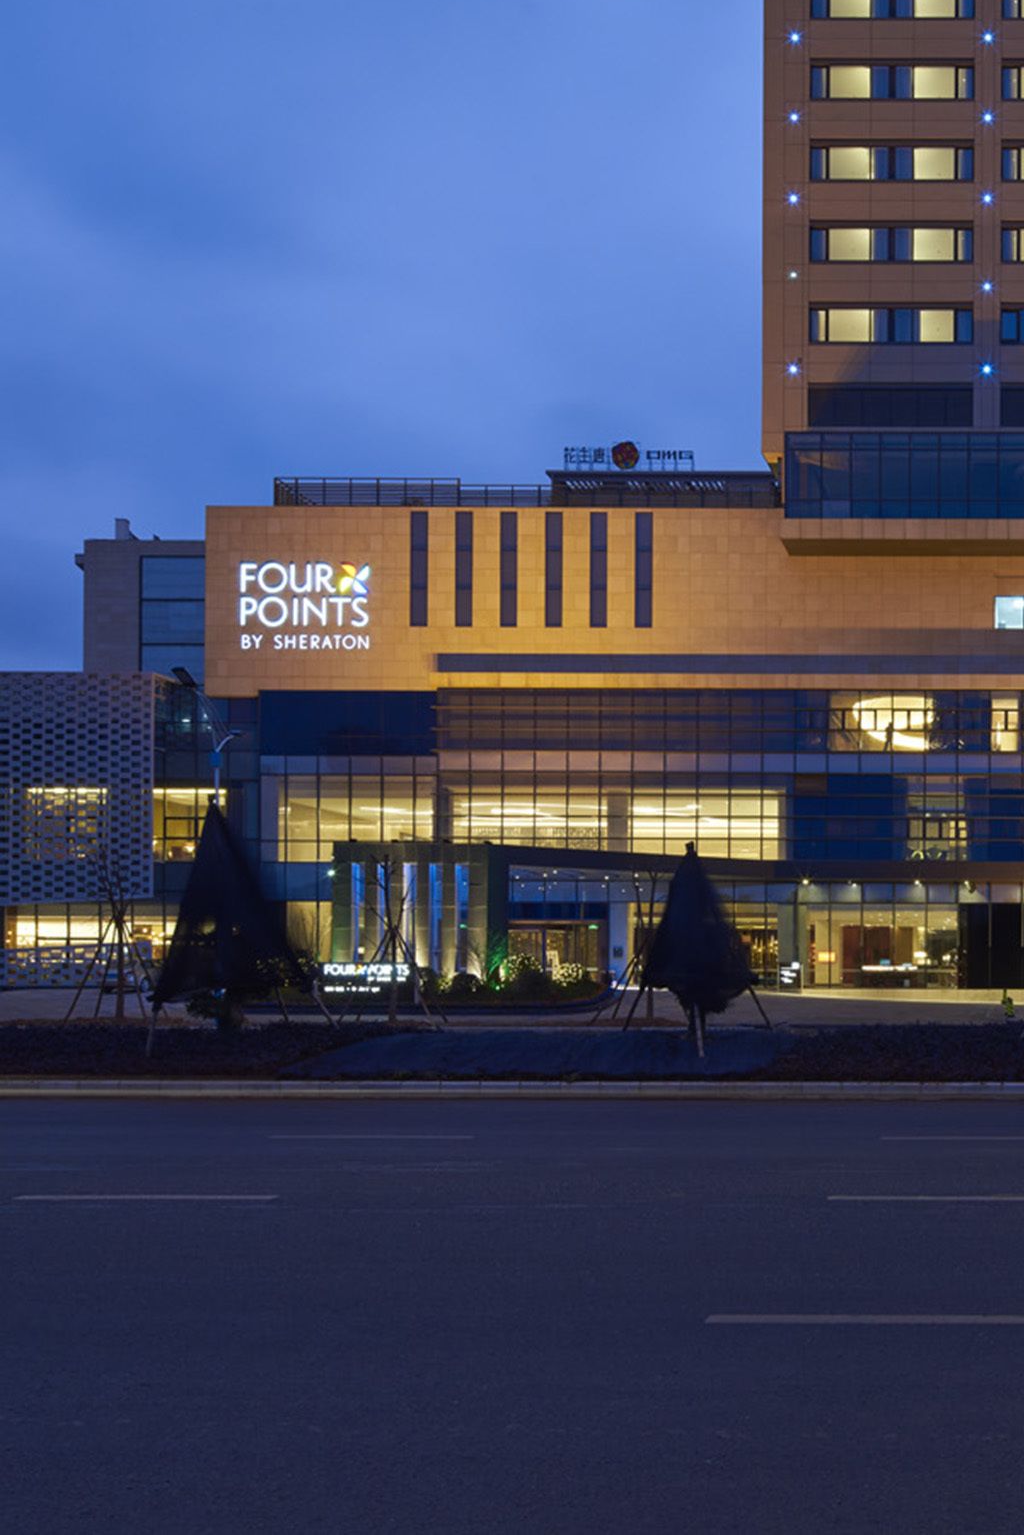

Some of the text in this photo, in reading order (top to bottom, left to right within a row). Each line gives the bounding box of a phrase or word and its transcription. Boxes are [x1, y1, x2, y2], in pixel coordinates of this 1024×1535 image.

[239, 562, 337, 593] FOUR
[239, 596, 370, 628] POINTS
[241, 634, 370, 650] BY SHERATON
[323, 964, 356, 976] FOUR
